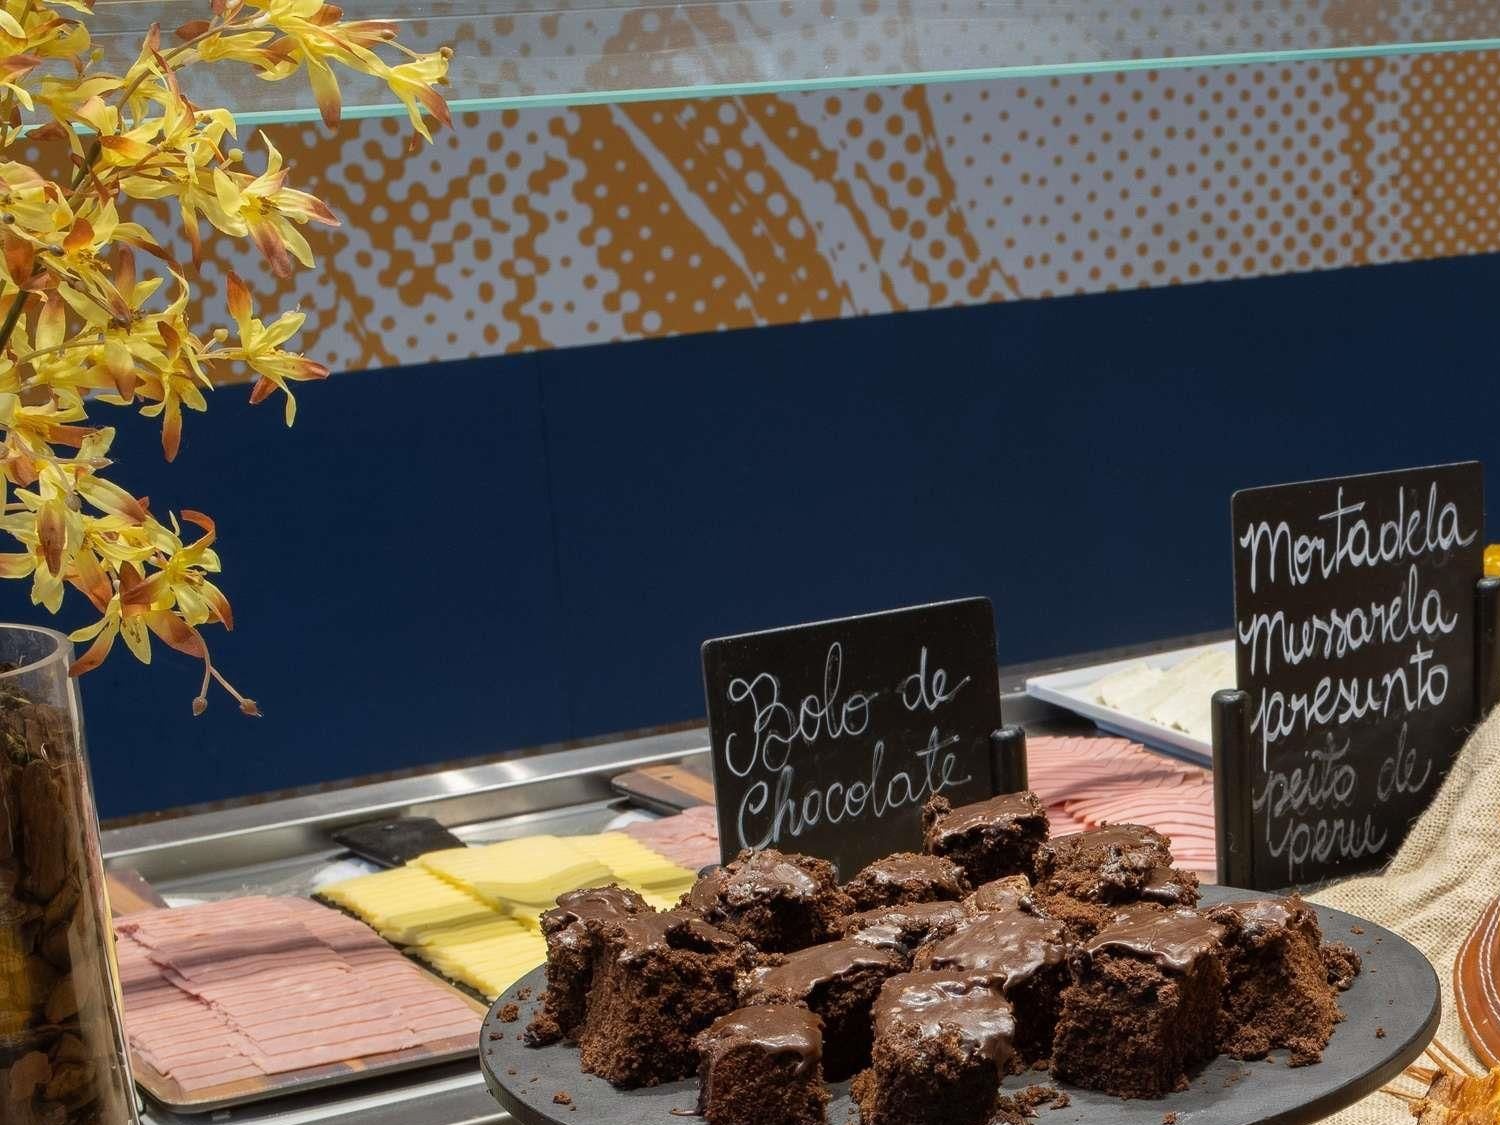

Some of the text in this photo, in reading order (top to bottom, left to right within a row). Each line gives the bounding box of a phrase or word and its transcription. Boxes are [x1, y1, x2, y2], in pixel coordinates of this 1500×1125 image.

[1240, 481, 1478, 594] Mortadela
[726, 642, 971, 777] Bolo de
[1250, 640, 1449, 772] presunto
[1376, 721, 1433, 801] de
[737, 726, 973, 852] Chocolate
